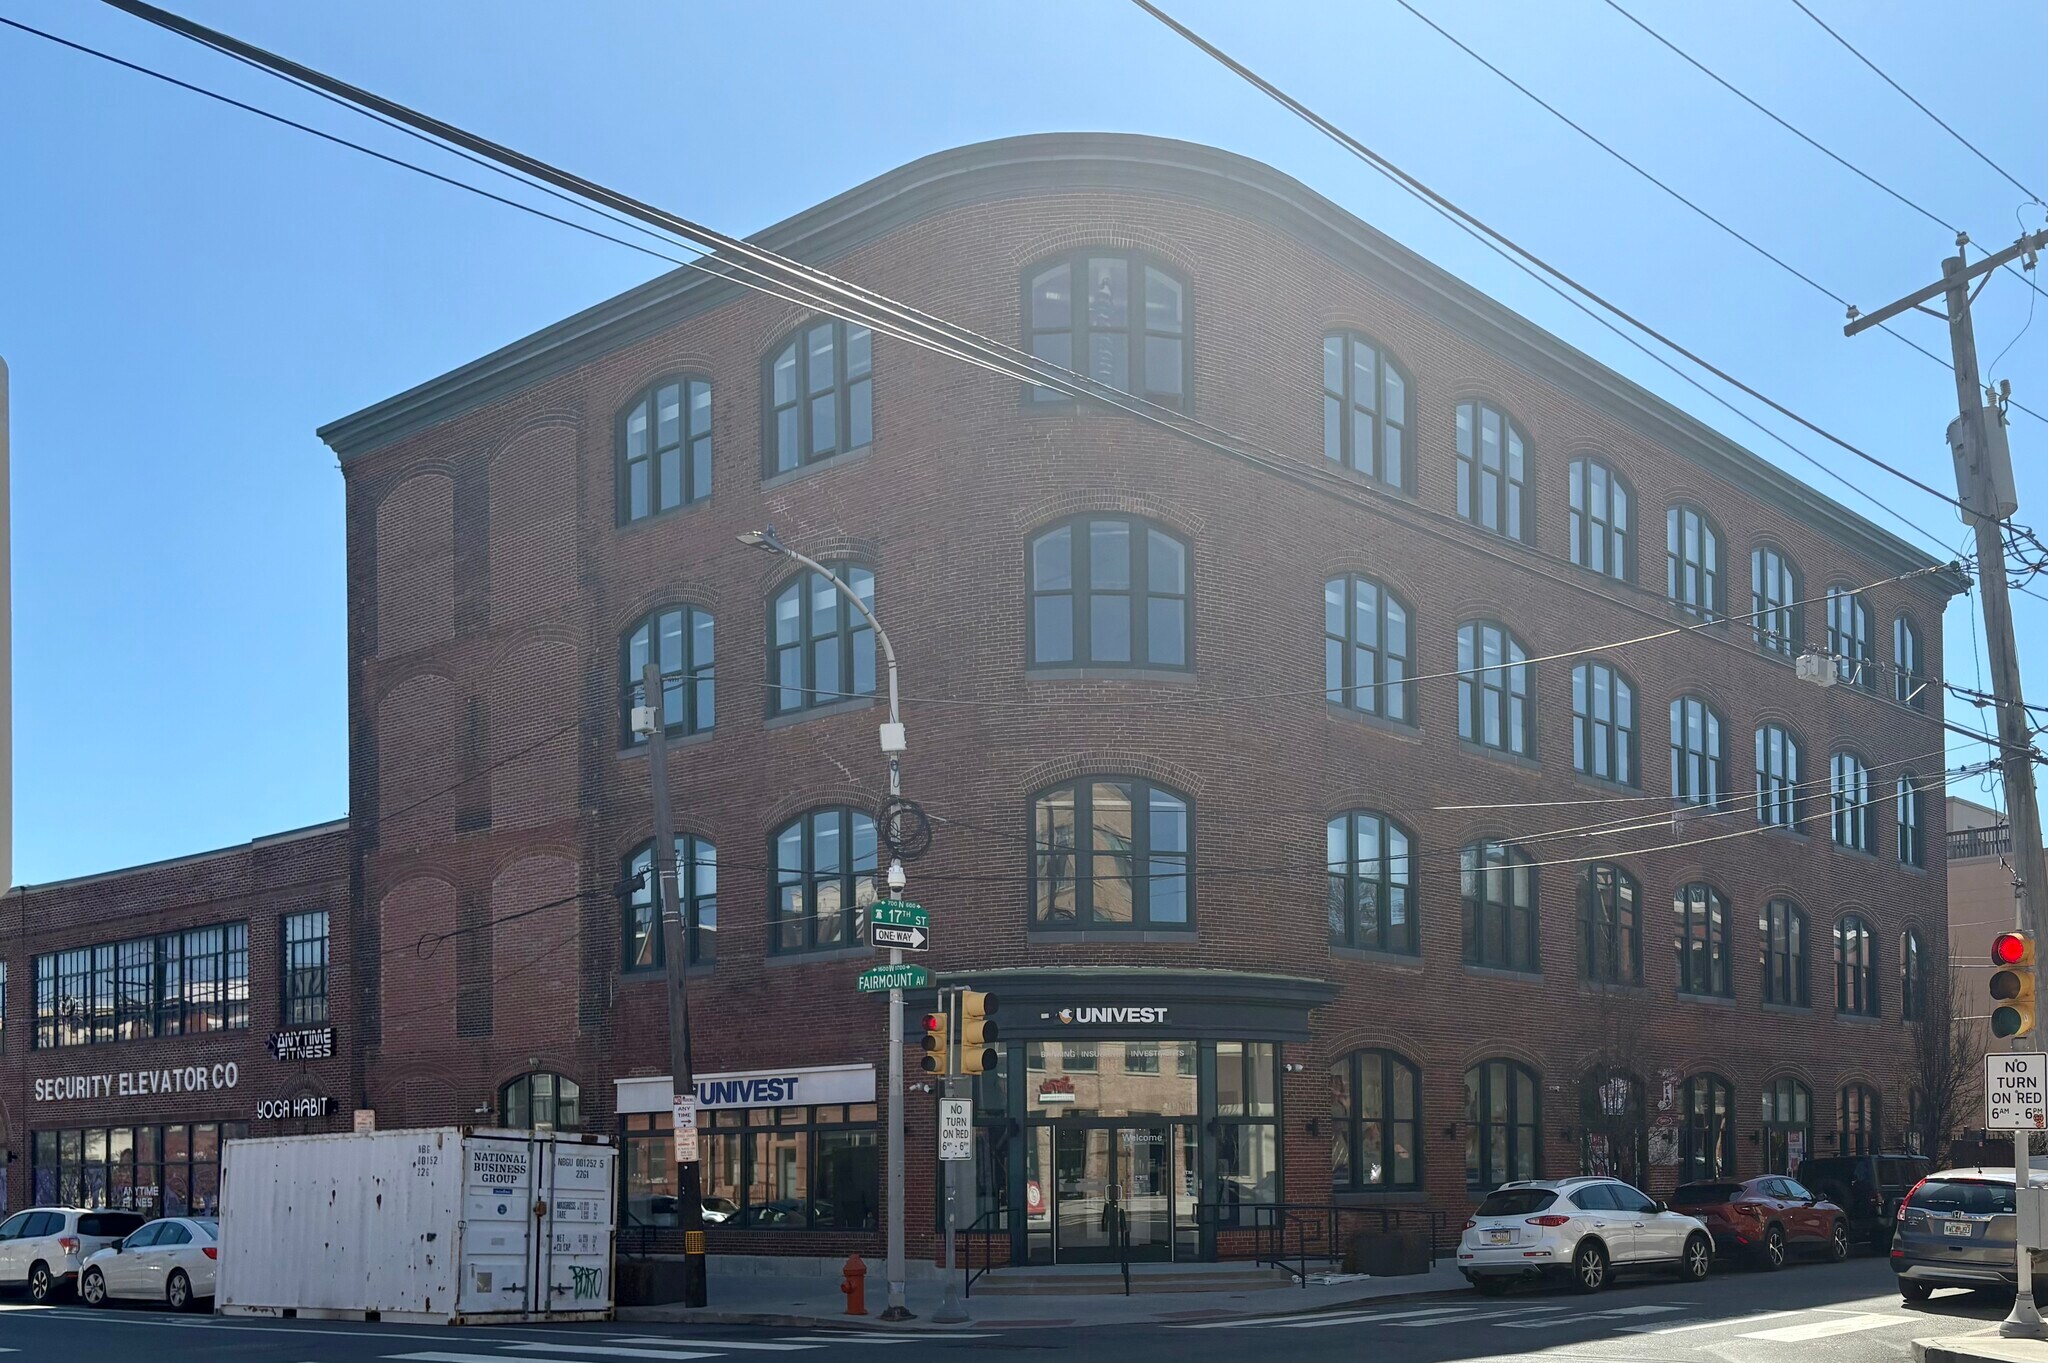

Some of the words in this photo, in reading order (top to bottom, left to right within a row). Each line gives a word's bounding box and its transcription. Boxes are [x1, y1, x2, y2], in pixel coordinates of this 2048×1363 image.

[898, 900, 904, 908] N
[888, 909, 911, 923] 17TH
[915, 915, 927, 926] ST
[878, 929, 895, 941] ONE
[896, 931, 912, 942] WAY
[858, 972, 913, 990] FAIRMOUNT
[915, 975, 925, 986] AV
[1076, 1007, 1168, 1023] UNIVEST
[277, 1027, 332, 1048] ANYTIME
[278, 1044, 332, 1061] FITNESS
[1040, 1050, 1077, 1058] BKING
[2005, 1061, 2028, 1073] NO
[35, 1074, 113, 1101] SECURITY
[119, 1066, 208, 1096] ELEVATOR
[212, 1061, 239, 1089] CO
[1996, 1076, 2037, 1089] TURN
[700, 1077, 799, 1105] UNIVEST
[1991, 1092, 2011, 1104] ON
[2016, 1092, 2042, 1104] RED
[256, 1099, 290, 1119] YOGA
[293, 1097, 328, 1118] HABIT
[950, 1104, 963, 1115] NO
[1991, 1107, 2010, 1119] 6AM
[2025, 1107, 2043, 1119] 6PM
[946, 1117, 967, 1127] TURN
[942, 1129, 954, 1139] ON
[955, 1129, 969, 1139] RED
[1122, 1133, 1163, 1142] Welcome
[474, 1152, 527, 1164] NATIONAL
[473, 1163, 527, 1174] BUSINESS
[481, 1173, 518, 1184] GROUP
[123, 1186, 159, 1197] ANYTIME
